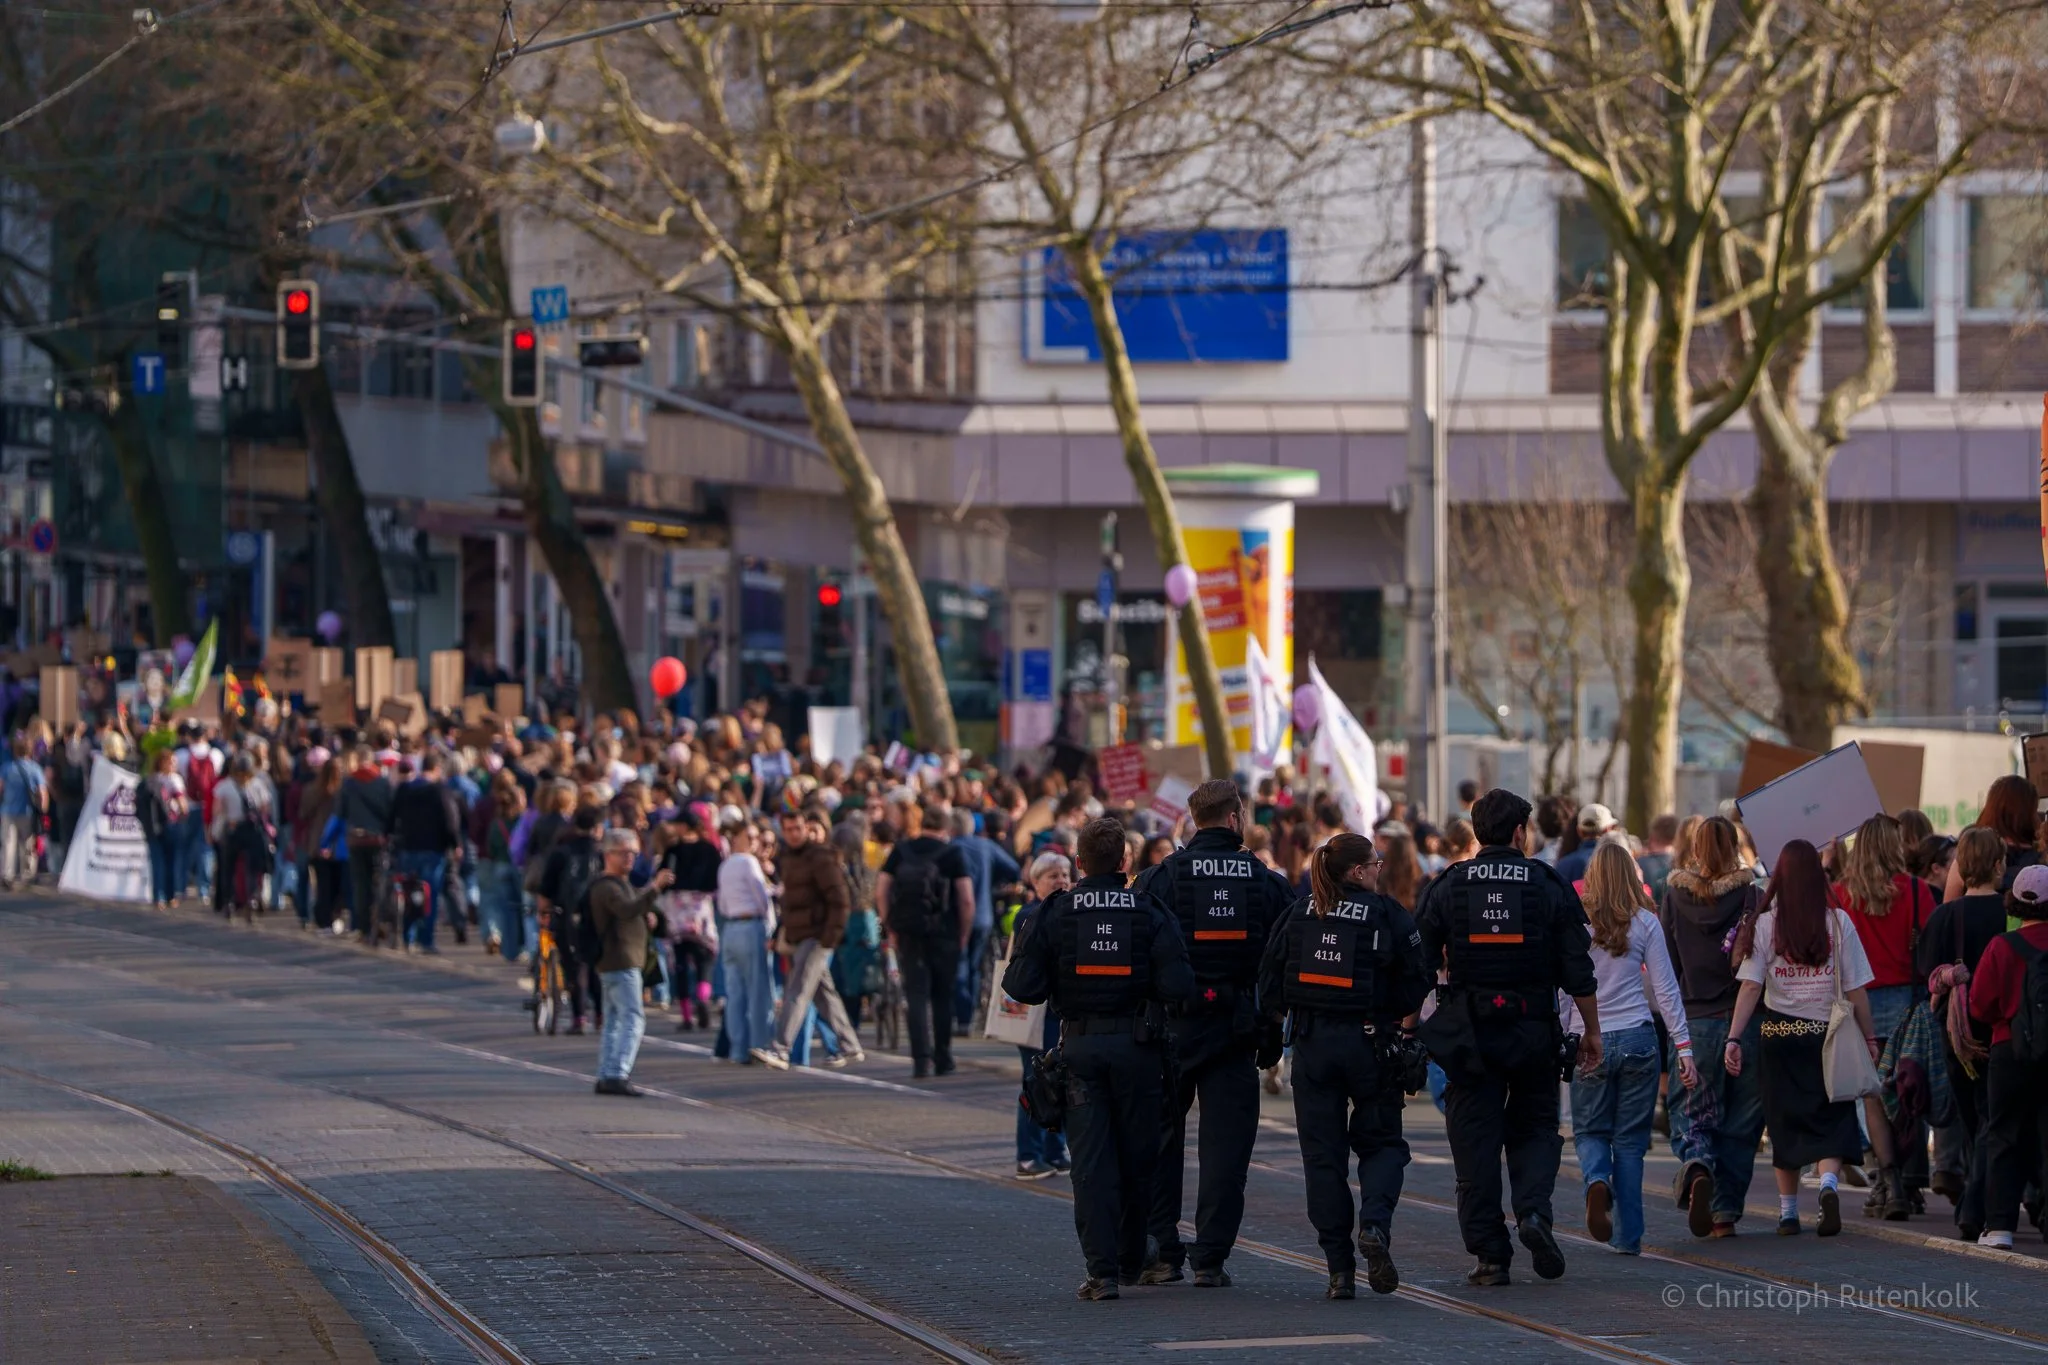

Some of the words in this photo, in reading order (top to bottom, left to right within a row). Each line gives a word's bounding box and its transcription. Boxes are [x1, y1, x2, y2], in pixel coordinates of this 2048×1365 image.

[222, 356, 248, 390] H
[1193, 859, 1252, 878] POLIZEI
[1467, 863, 1529, 882] POLIZEI
[1073, 891, 1136, 910] POLIZEI
[1214, 890, 1229, 901] HE
[1487, 893, 1503, 903] HE
[1208, 906, 1236, 917] 4114
[1306, 899, 1369, 921] PIZEI
[1482, 909, 1510, 920] 4114
[1097, 924, 1113, 934] HE
[1322, 933, 1338, 945] HE
[1090, 940, 1119, 951] 4114
[1314, 949, 1342, 962] 4114
[1775, 966, 1810, 978] PASTA
